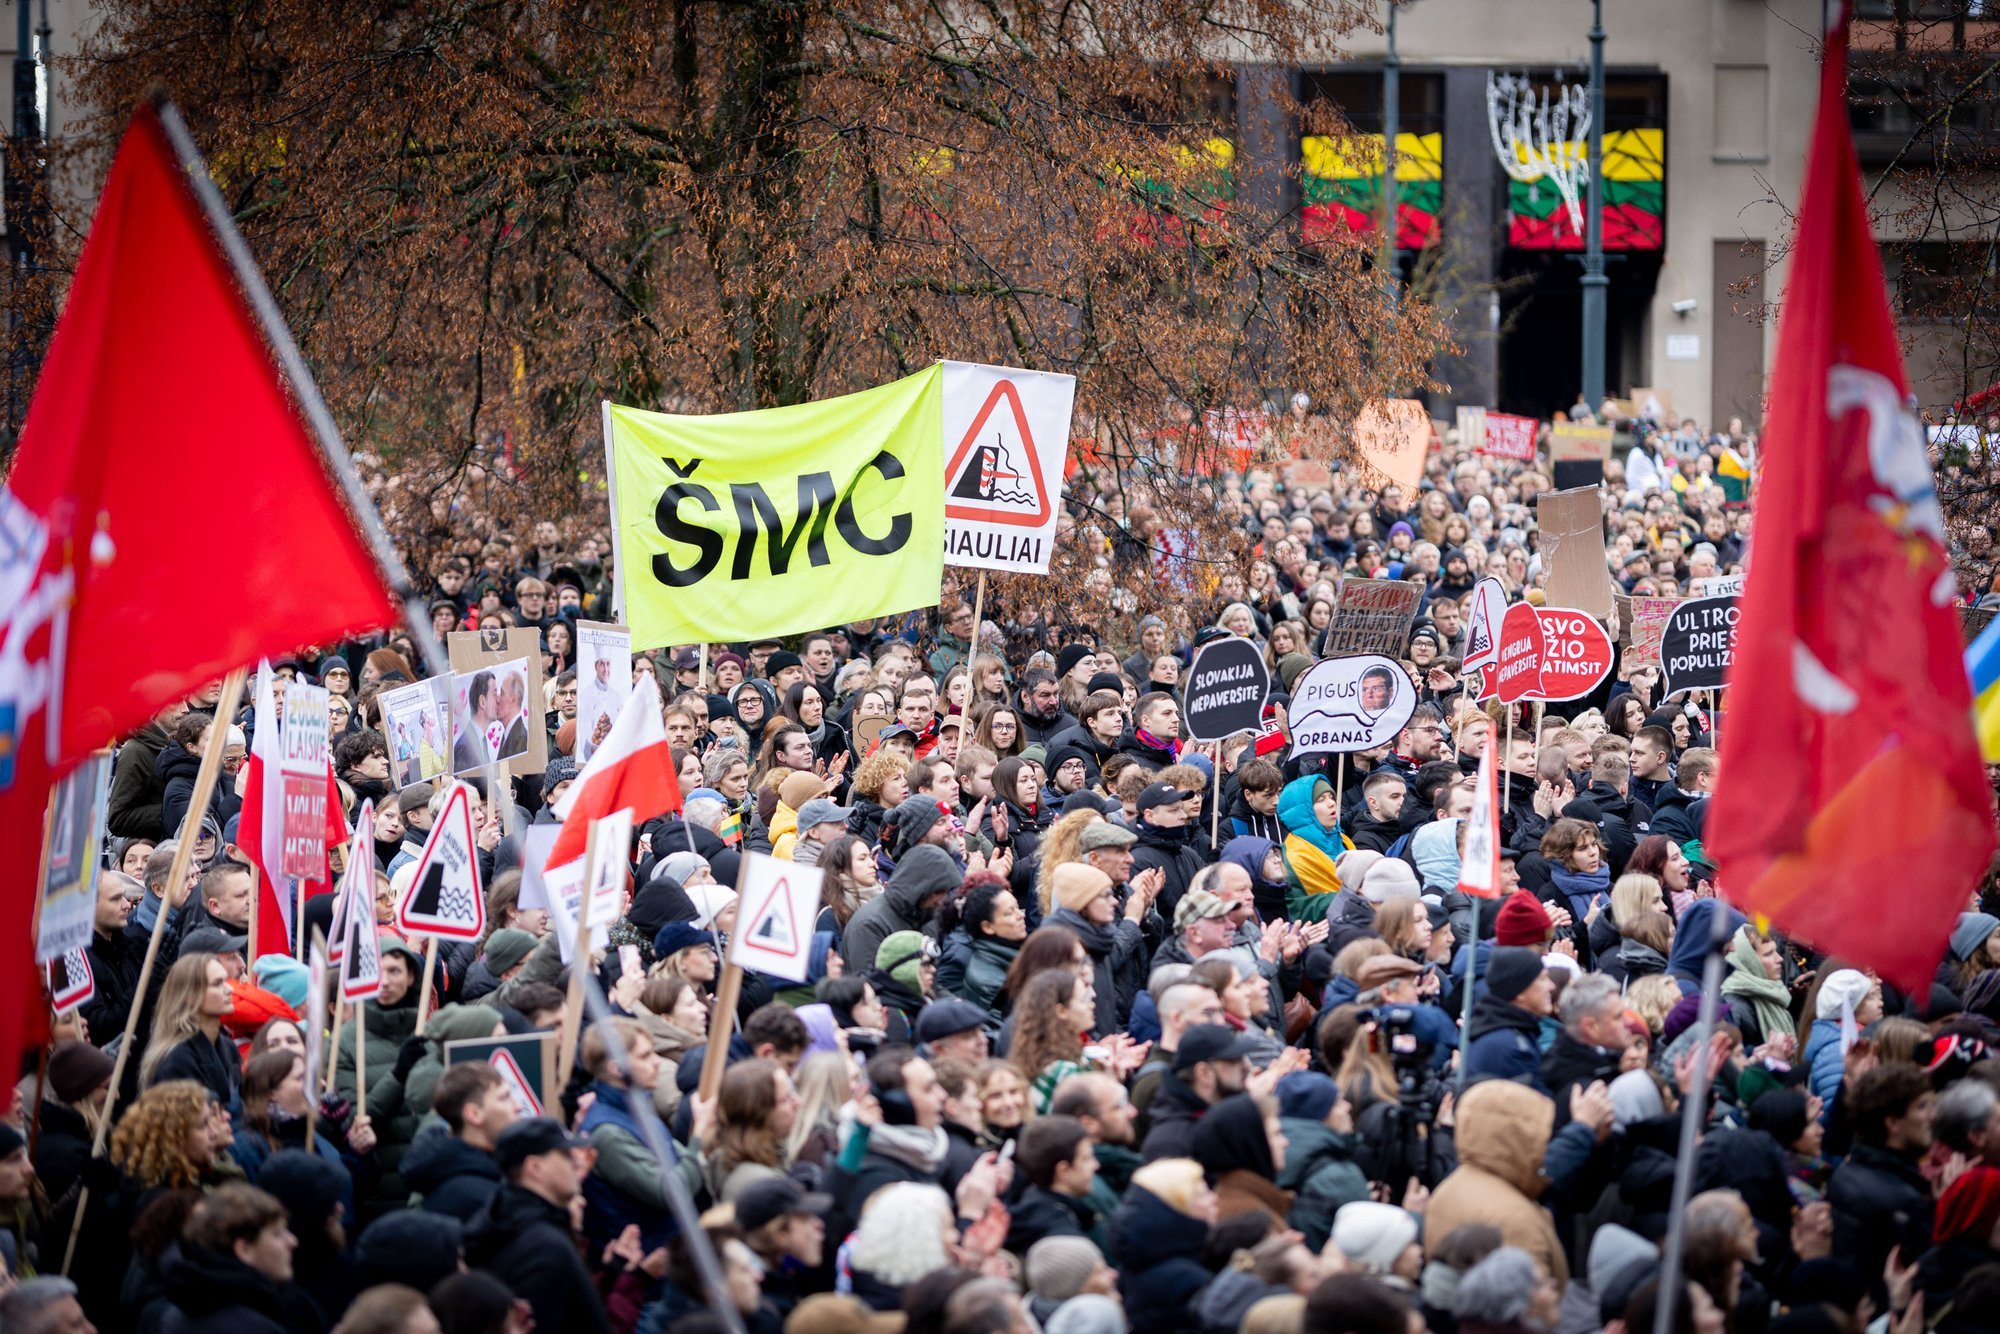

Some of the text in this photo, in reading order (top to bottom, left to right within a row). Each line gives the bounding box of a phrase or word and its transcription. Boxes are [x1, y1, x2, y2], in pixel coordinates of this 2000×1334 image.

[651, 449, 913, 588] ŠMC
[944, 521, 1041, 563] IAULIAI
[1676, 606, 1742, 631] ULTRO
[1329, 630, 1404, 656] TELEVIZIJA
[1689, 626, 1738, 652] PRIEŠ
[1195, 664, 1255, 691] SLOVAKIJA
[1307, 681, 1357, 700] PIGUS
[1190, 685, 1260, 715] NEPAVERSITE
[1299, 729, 1373, 747] ORBANAS
